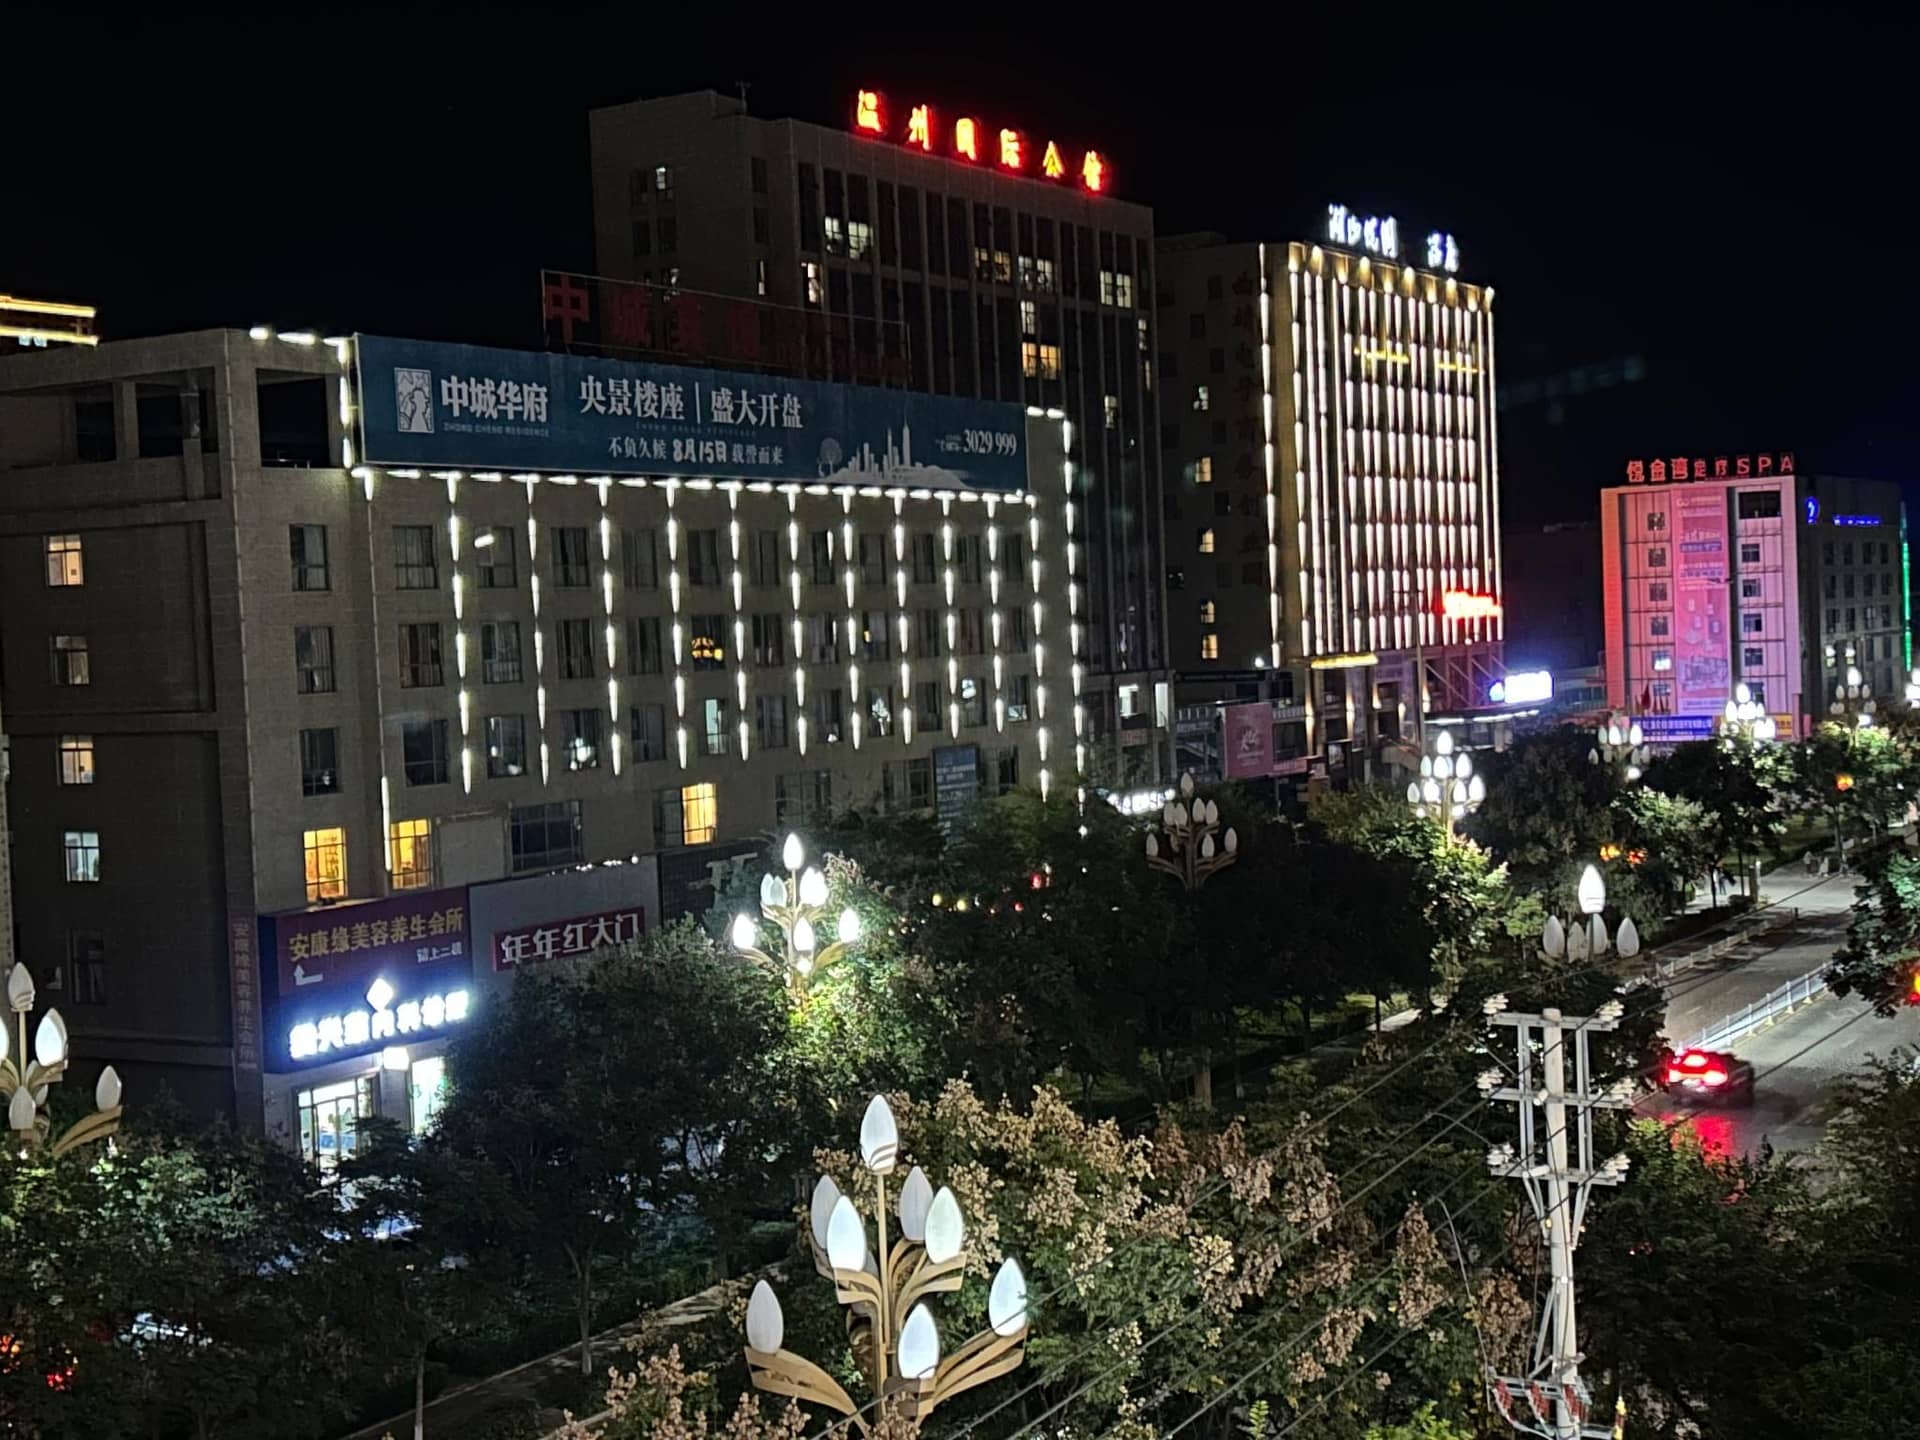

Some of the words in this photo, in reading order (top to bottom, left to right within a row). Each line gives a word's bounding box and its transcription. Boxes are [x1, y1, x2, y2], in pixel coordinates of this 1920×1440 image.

[441, 375, 549, 423] 中城华府
[579, 375, 685, 420] 央景楼座
[711, 386, 804, 429] 盛大开盘
[443, 422, 473, 433] ZHONG
[475, 424, 503, 435] CHENG
[672, 438, 728, 464] 8月15日
[963, 429, 993, 454] 3029
[995, 431, 1017, 456] 999
[288, 907, 465, 961] 安康缘美容养生会所
[501, 913, 639, 964] 年年红大门
